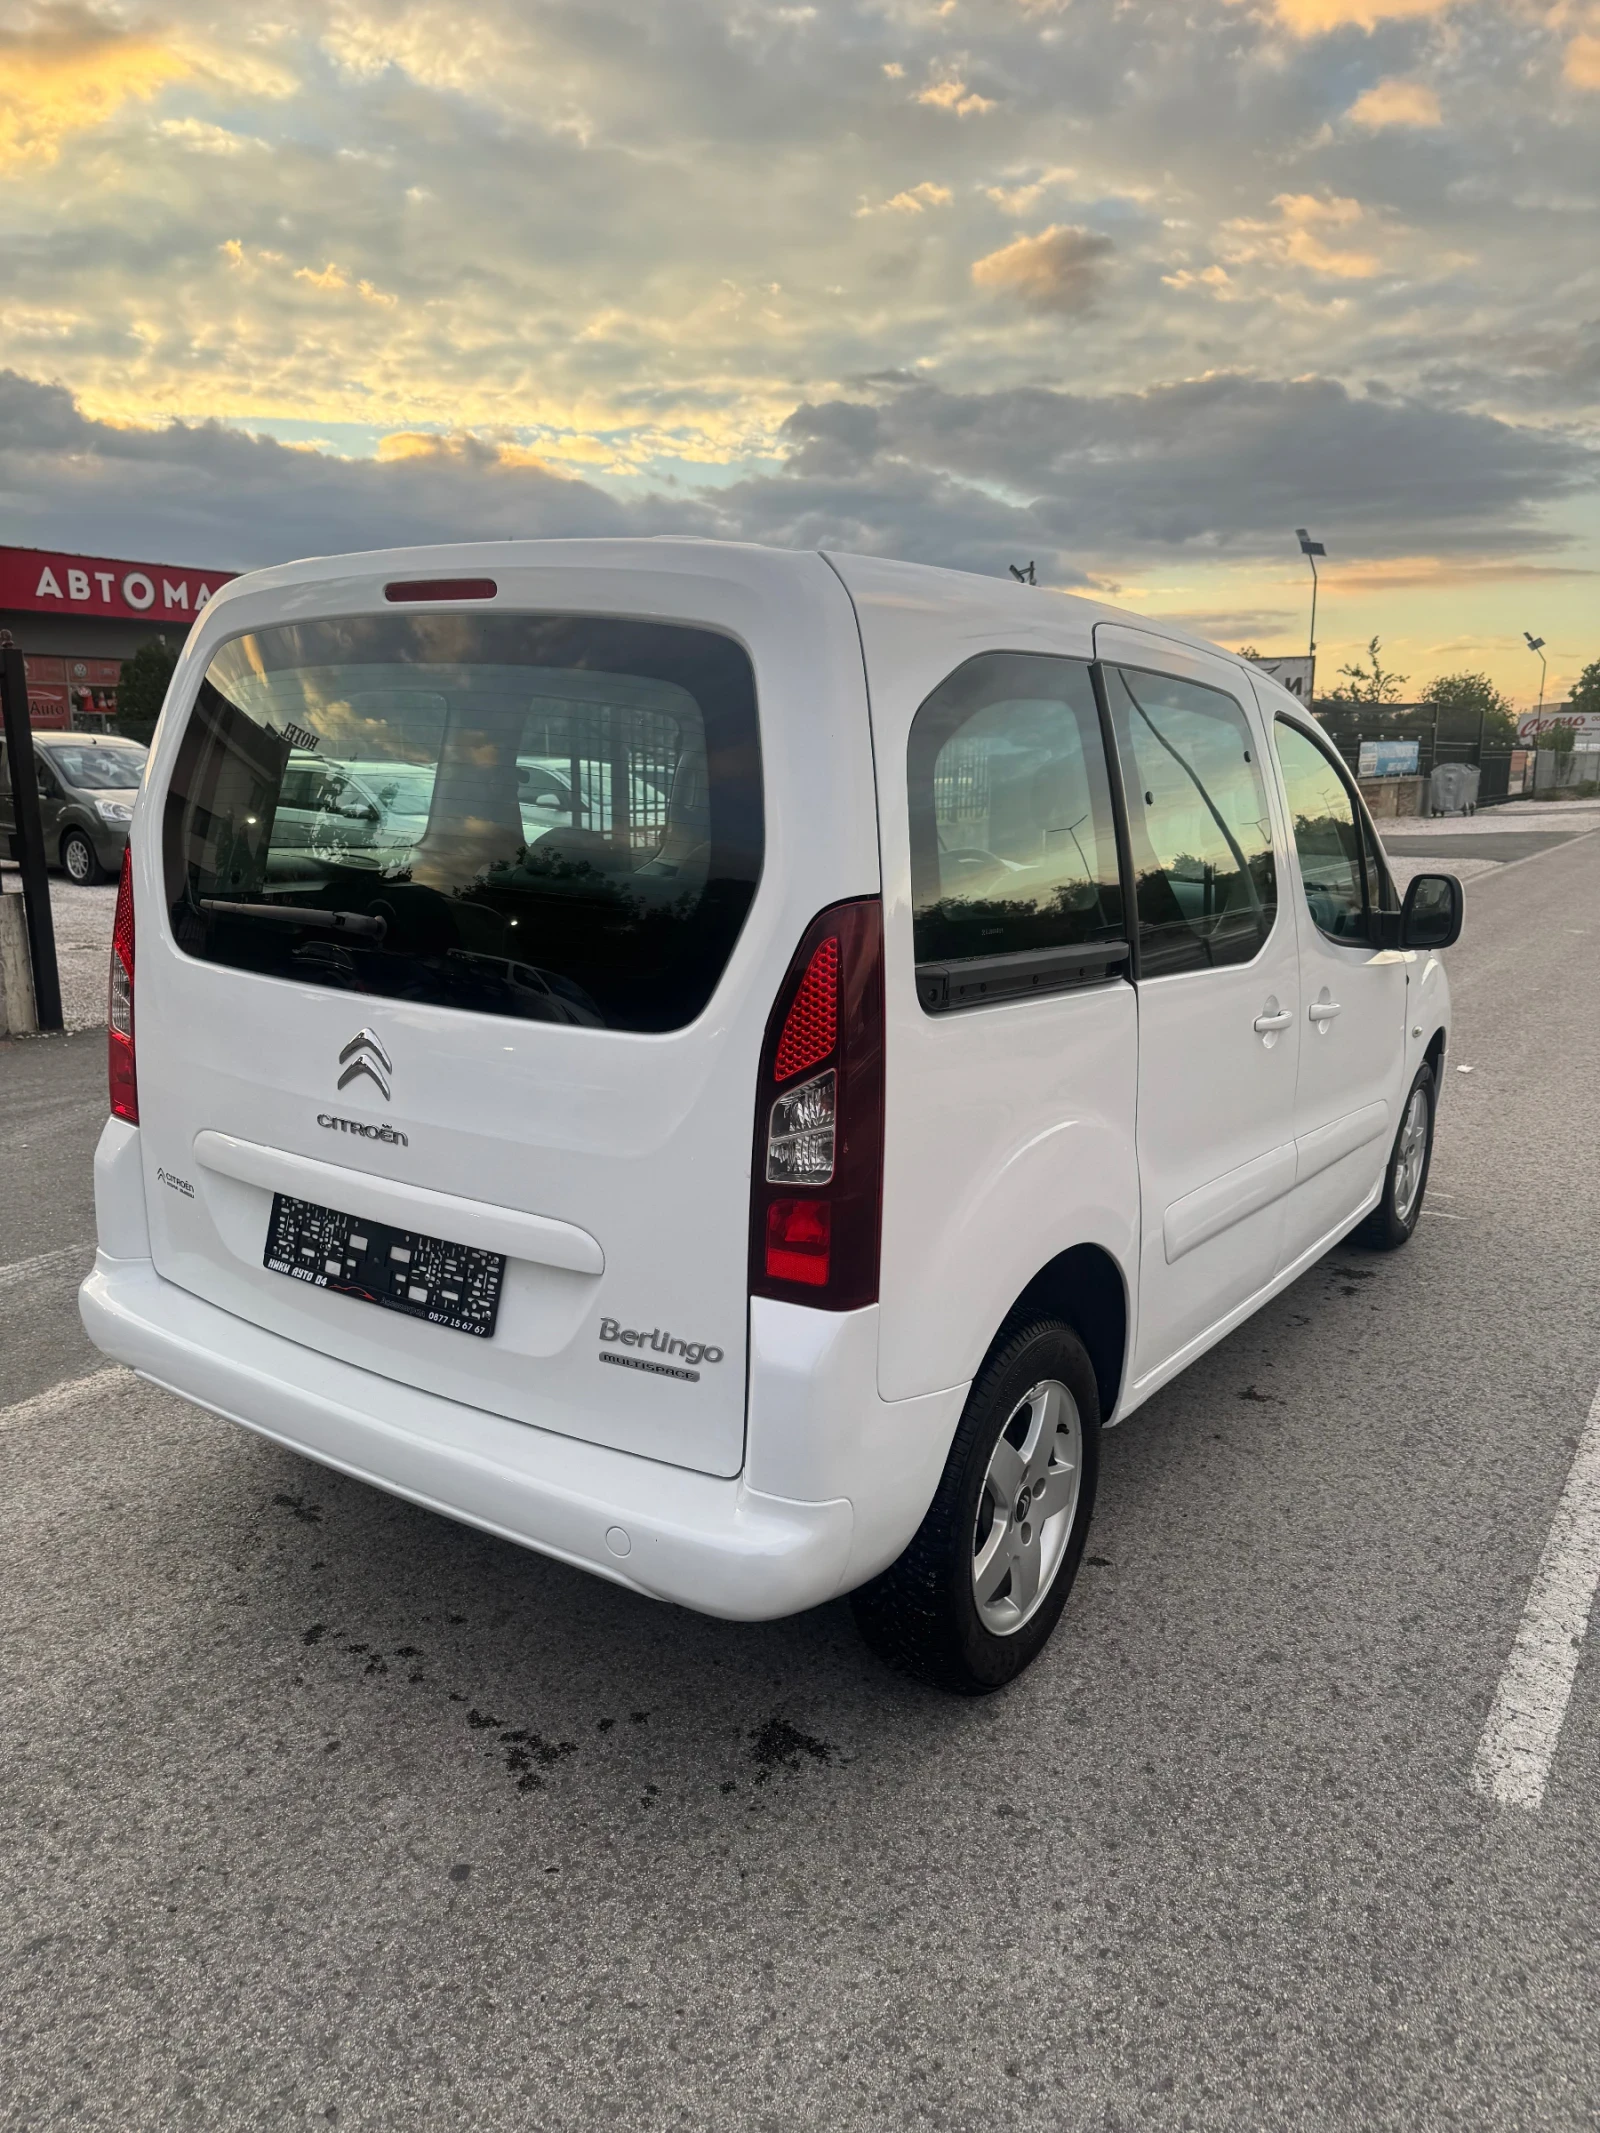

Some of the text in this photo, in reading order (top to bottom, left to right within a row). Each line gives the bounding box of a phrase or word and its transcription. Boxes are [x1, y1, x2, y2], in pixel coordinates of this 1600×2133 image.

[30, 702, 64, 715] Auto
[267, 1258, 291, 1274] НИКИ
[291, 1267, 314, 1281] АУТО
[428, 1311, 486, 1335] 0877 15 67 67
[599, 1317, 724, 1364] Berlingo
[603, 1354, 695, 1380] MULTISPACE
